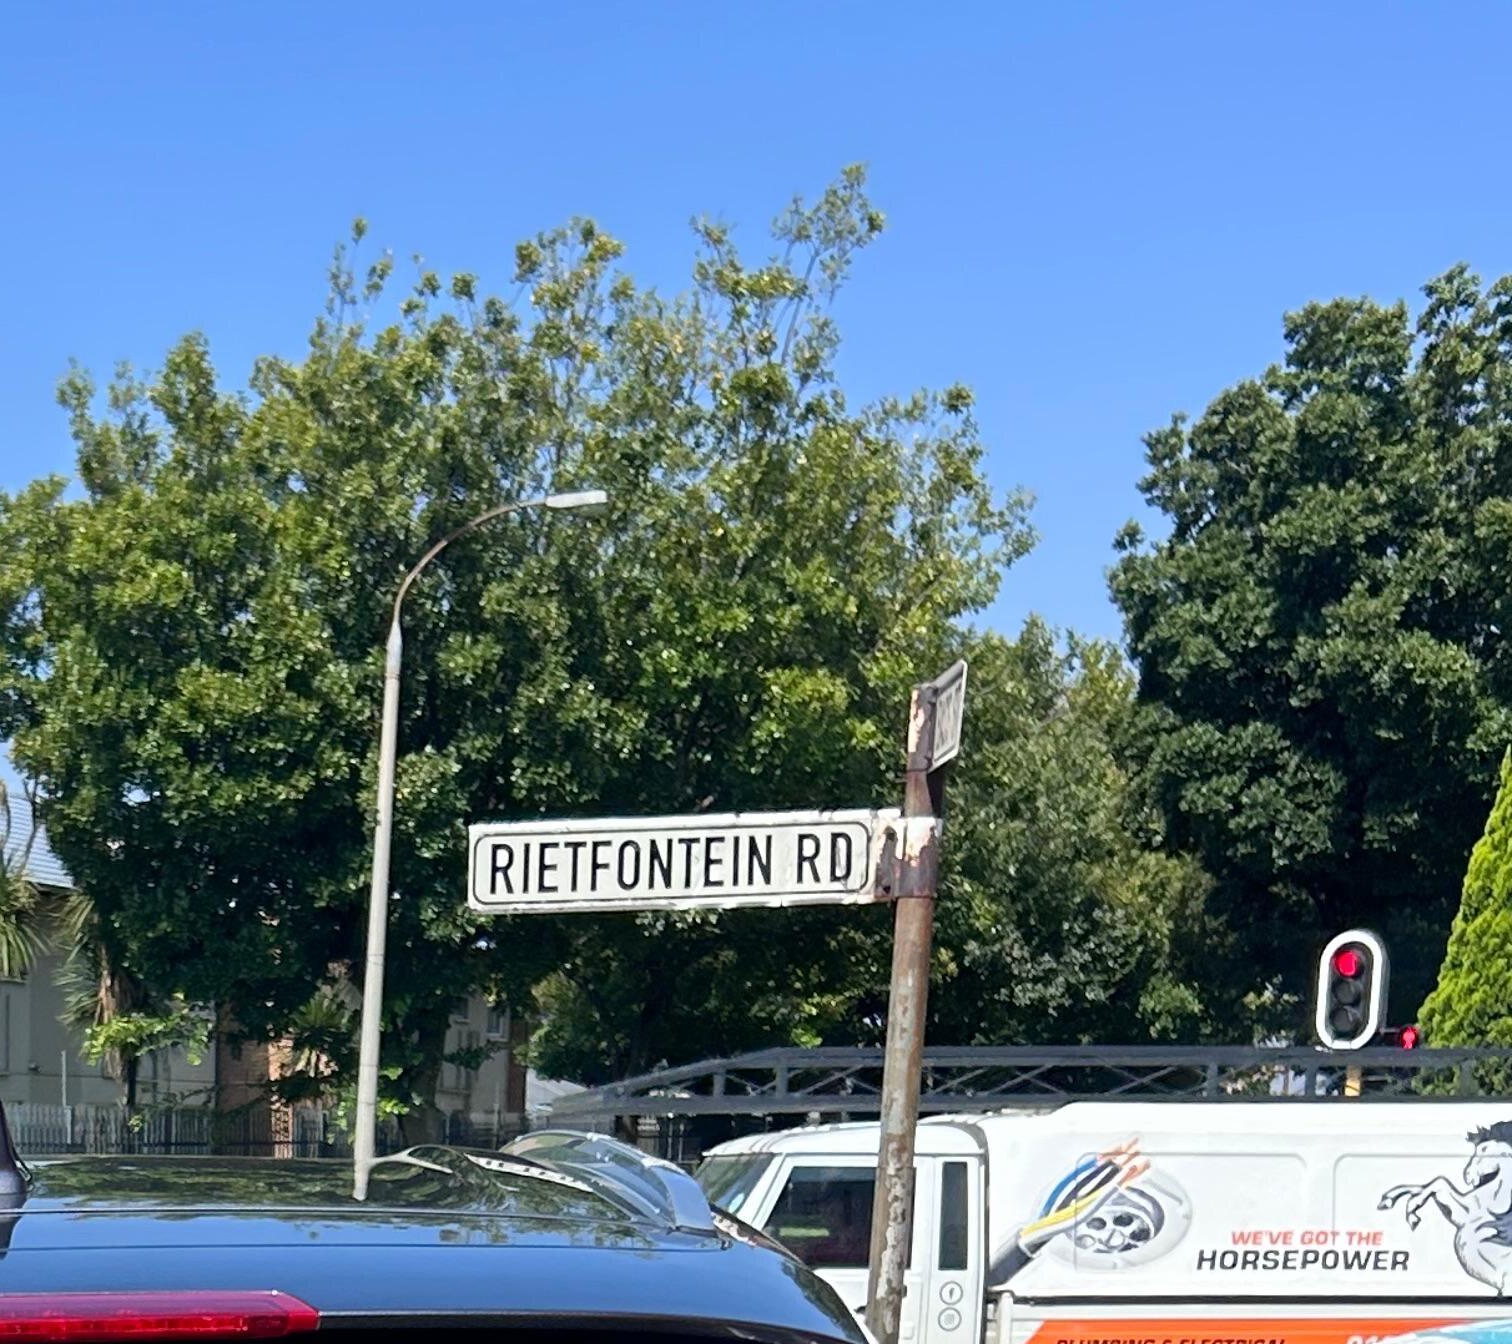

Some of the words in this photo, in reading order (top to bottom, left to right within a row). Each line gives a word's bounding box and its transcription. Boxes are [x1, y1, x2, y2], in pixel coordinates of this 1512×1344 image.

[488, 834, 773, 895] RIETFONTEIN
[795, 831, 854, 884] RD
[1231, 1230, 1295, 1246] WE'VE
[1300, 1230, 1340, 1246] GOT
[1345, 1230, 1384, 1246] THE
[1196, 1249, 1410, 1271] HORSEPOWER
